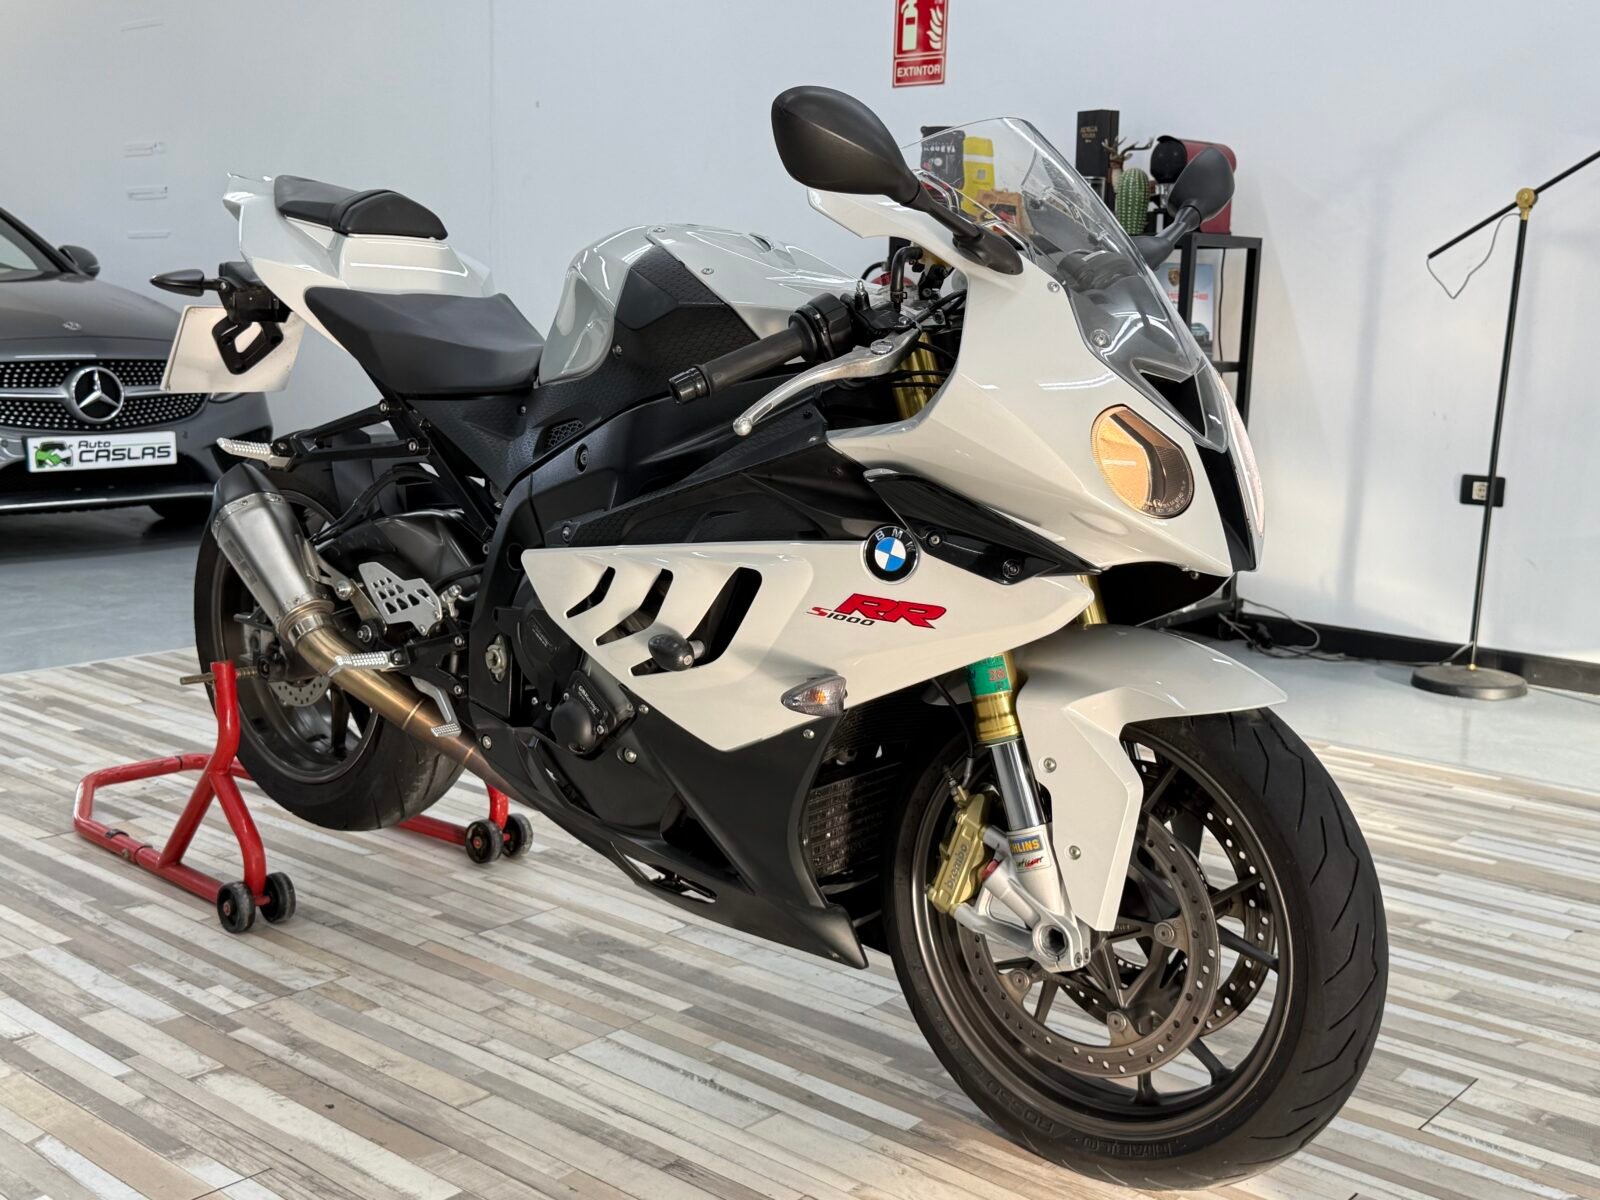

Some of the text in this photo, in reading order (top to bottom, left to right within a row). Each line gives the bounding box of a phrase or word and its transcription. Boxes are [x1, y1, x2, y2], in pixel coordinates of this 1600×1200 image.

[897, 64, 941, 78] EXTINTOR
[78, 440, 111, 449] Auto
[79, 445, 172, 463] CASLAS
[874, 527, 916, 553] BMW
[805, 593, 947, 630] S1000 RR
[1010, 838, 1041, 854] HLINS
[944, 844, 970, 889] brembo
